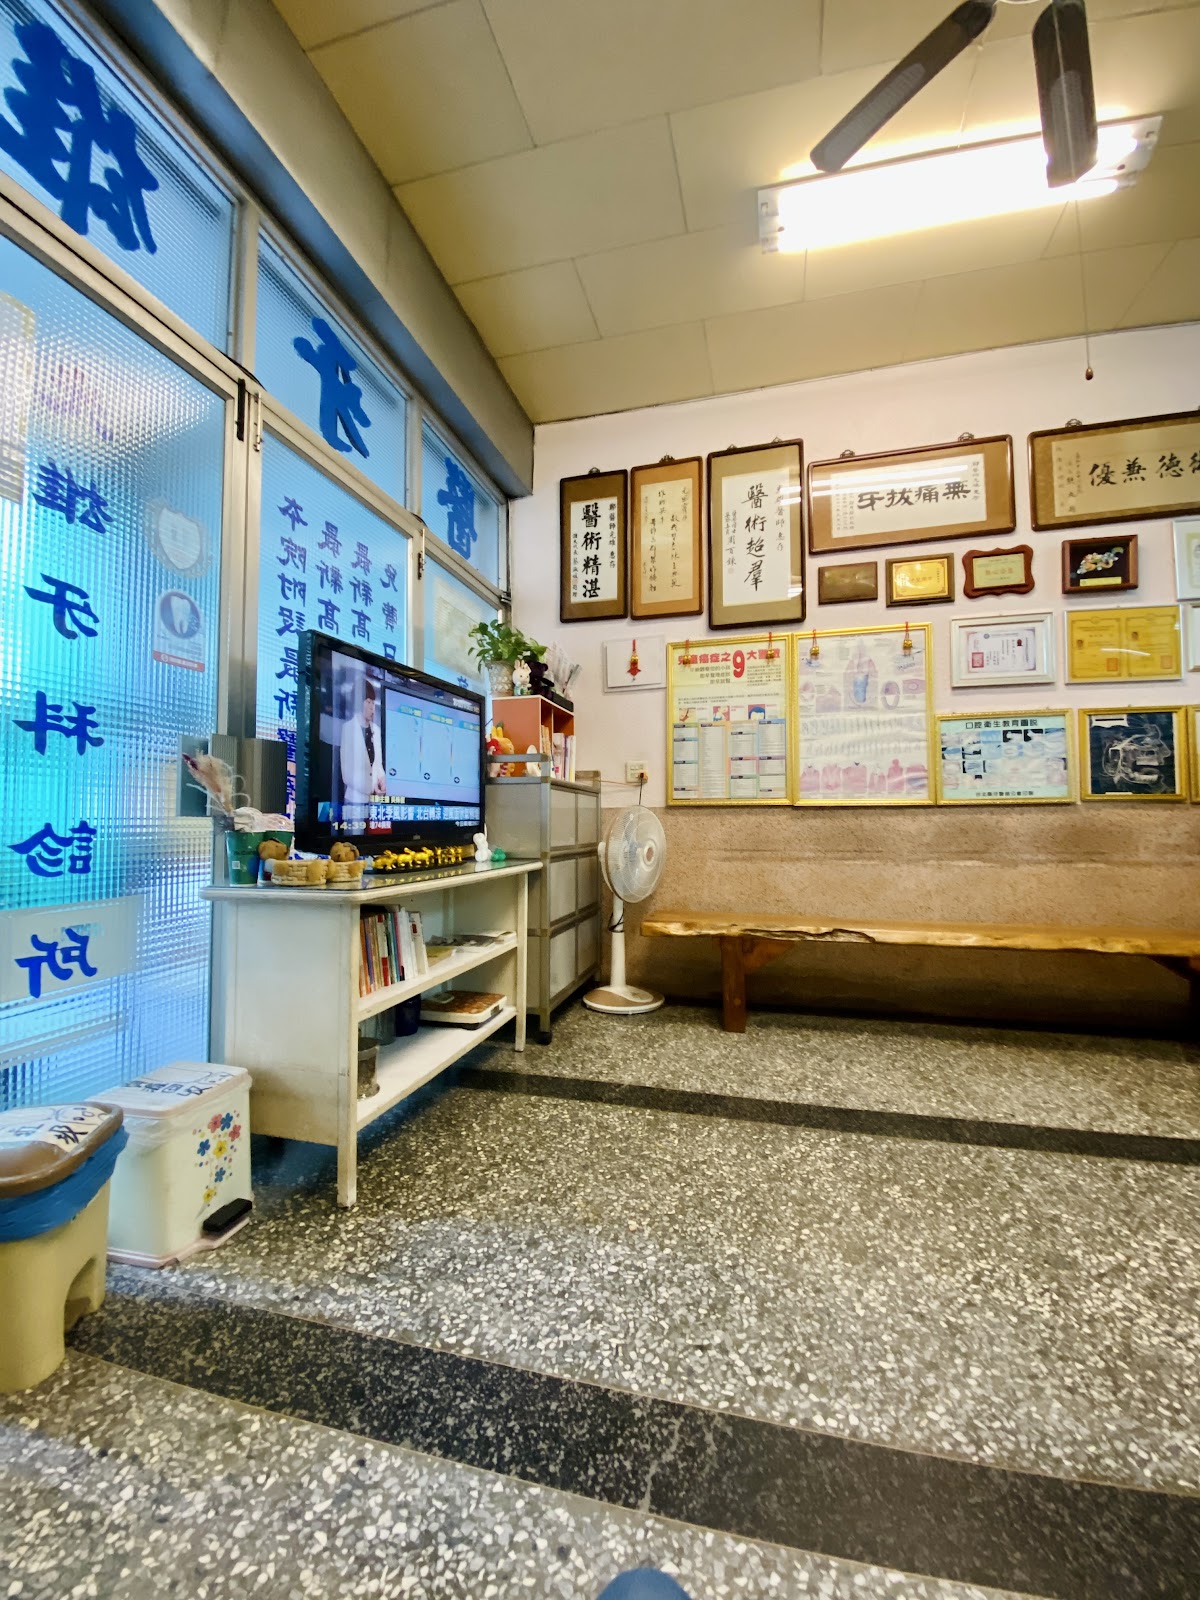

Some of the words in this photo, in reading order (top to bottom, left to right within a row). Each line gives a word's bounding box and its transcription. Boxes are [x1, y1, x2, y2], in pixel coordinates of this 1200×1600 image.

[856, 479, 972, 511] 無痛拔牙
[580, 502, 603, 599] 醫術精湛
[369, 804, 415, 821] 東北季風影響
[332, 821, 367, 831] 14:39
